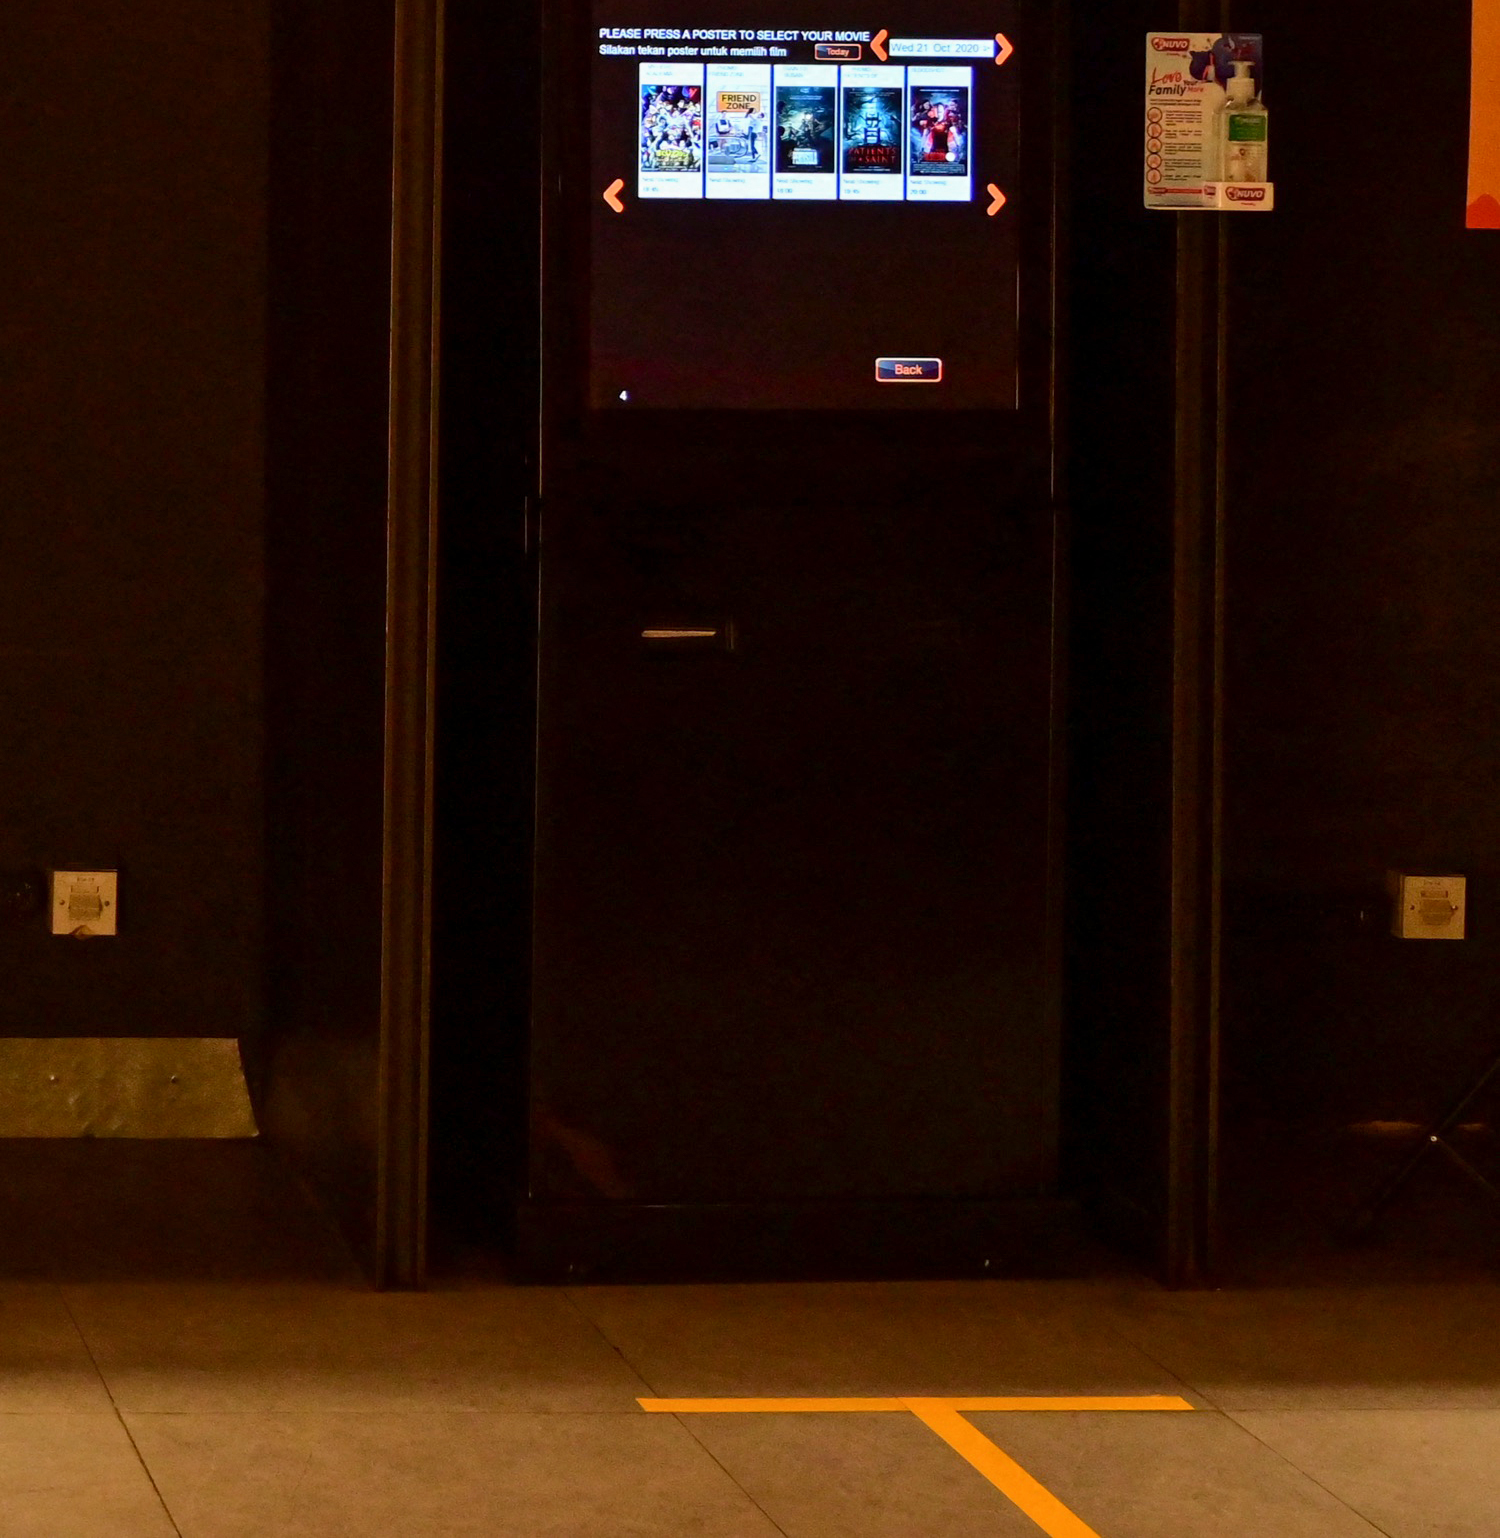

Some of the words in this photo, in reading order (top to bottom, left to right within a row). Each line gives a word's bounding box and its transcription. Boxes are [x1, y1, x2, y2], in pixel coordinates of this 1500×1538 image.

[599, 28, 641, 39] PLEASE
[643, 29, 681, 39] PRESS
[682, 29, 691, 39] A
[692, 29, 737, 40] POSTER
[739, 30, 755, 40] TO
[756, 30, 799, 40] SELECT
[799, 30, 833, 41] YOUR
[835, 30, 870, 42] MOVIE
[599, 44, 636, 55] Silakan
[637, 45, 665, 55] tekan
[667, 45, 698, 57] poster
[700, 46, 728, 56] untuk
[730, 46, 767, 56] memilih
[769, 46, 787, 56] film
[826, 47, 850, 58] Today
[891, 42, 914, 53] Wed
[916, 43, 928, 53] 21
[933, 43, 951, 54] Oct
[955, 43, 979, 54] 2020
[1151, 66, 1182, 85] Love
[1148, 84, 1187, 97] Family
[721, 94, 757, 103] FRIEND
[725, 102, 751, 110] ZONE
[848, 147, 897, 155] PATIENTS
[1236, 189, 1264, 199] NUVO
[894, 363, 923, 376] Back
